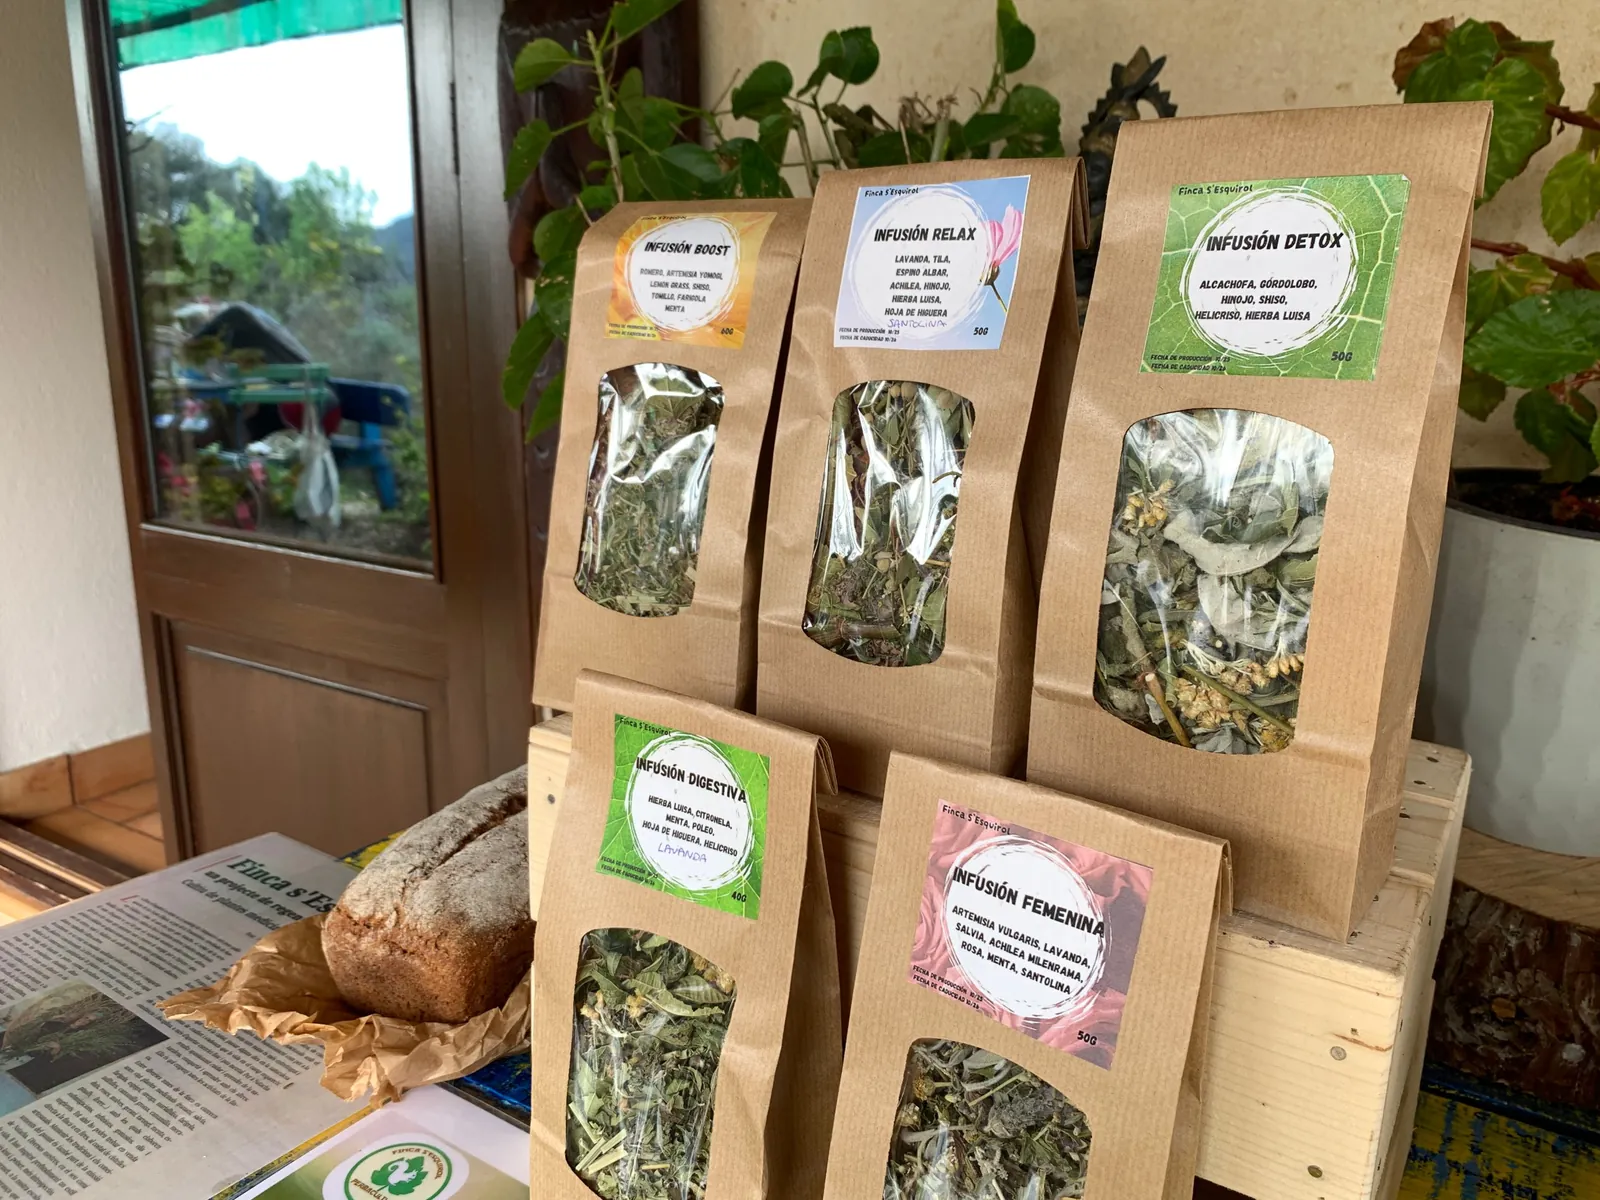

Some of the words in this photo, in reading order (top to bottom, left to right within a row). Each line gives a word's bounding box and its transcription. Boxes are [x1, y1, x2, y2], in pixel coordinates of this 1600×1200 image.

[865, 188, 883, 197] Finca
[885, 187, 919, 197] S'Esquirol
[1178, 187, 1204, 196] Finca
[1206, 184, 1253, 195] S'Esquirol
[874, 224, 929, 242] INFUSIÓN
[932, 227, 976, 241] RELAX
[644, 240, 692, 254] INFUSIÓN
[694, 243, 731, 257] BOOST
[1206, 230, 1280, 252] INFUSIÓN
[1284, 232, 1344, 250] DETOX
[895, 255, 930, 264] LAVANDA,
[933, 255, 951, 264] TILA,
[640, 268, 664, 276] ROMERO,
[666, 269, 697, 278] ARTEMISIA
[896, 268, 920, 276] ESPINO
[923, 268, 948, 277] ALBAR,
[890, 282, 921, 290] ACHILEA,
[923, 282, 951, 291] HINOJO,
[1199, 279, 1257, 289] ALCACHOFA,
[651, 292, 675, 300] TOMILLO,
[892, 295, 917, 303] HIERBA
[920, 295, 942, 304] LUISA,
[1221, 295, 1256, 305] HINOJO,
[1258, 295, 1288, 305] SHISO,
[884, 308, 903, 316] HOJA
[906, 308, 916, 316] DE
[917, 309, 947, 317] HIGUERA
[1194, 311, 1242, 321] HELICRISO,
[1245, 311, 1280, 320] HIERBA
[1283, 311, 1311, 320] LUISA
[973, 327, 989, 336] 50G
[1331, 350, 1353, 362] 50G
[619, 717, 637, 728] Finca
[636, 757, 685, 783] INFUSIÓN
[689, 773, 747, 804] DIGESTIVA
[648, 795, 672, 809] HIERBA
[695, 810, 733, 830] CITRONELA,
[942, 804, 965, 819] Finca
[968, 813, 1011, 835] S'Esquirol
[665, 814, 690, 829] MENTA,
[642, 820, 660, 832] HOJA
[661, 826, 671, 836] DE
[672, 829, 702, 846] HIGUERA,
[704, 839, 738, 857] HELICRISO
[658, 842, 707, 863] LAVANDA
[227, 858, 292, 891] Finca
[286, 887, 336, 913] s'Es
[731, 891, 747, 902] 40G
[953, 867, 1018, 906] INFUSIÓN
[1022, 895, 1105, 938] FEMENINA
[257, 895, 274, 906] de
[271, 903, 303, 921] regen
[952, 905, 995, 930] ARTEMISIA
[998, 924, 1041, 950] VULGARIS,
[1043, 943, 1091, 968] LAVANDA,
[955, 922, 987, 943] SALVIA,
[989, 937, 1025, 959] ACHILEA
[1028, 953, 1084, 983] MILENRAMA,
[961, 940, 984, 959] ROSA,
[987, 952, 1018, 974] MENTA,
[1021, 967, 1071, 995] SANTOLINA
[913, 965, 929, 977] FECHA
[937, 976, 968, 994] PRODUCCIÓN
[913, 975, 930, 986] FECHA
[938, 986, 965, 1002] CADUCIDAD
[1077, 1030, 1098, 1046] 50G
